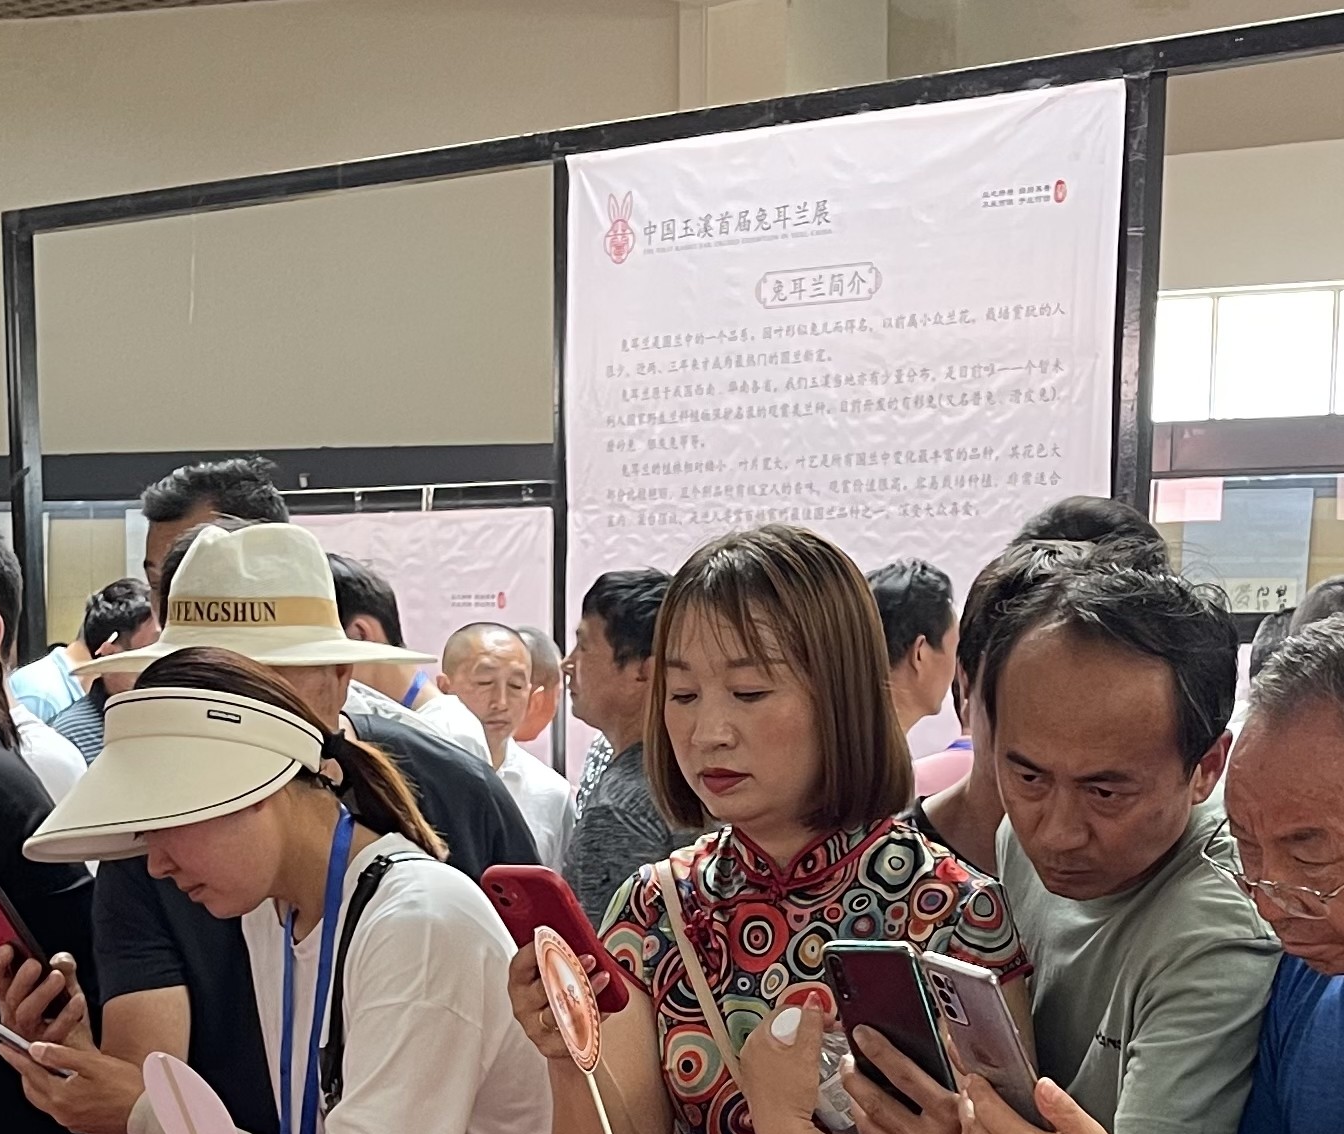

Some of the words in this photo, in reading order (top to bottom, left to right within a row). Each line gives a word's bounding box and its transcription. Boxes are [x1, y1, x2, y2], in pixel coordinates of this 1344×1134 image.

[643, 200, 832, 246] 中国玉溪首届兔耳兰展
[771, 270, 866, 302] 兔耳兰简介
